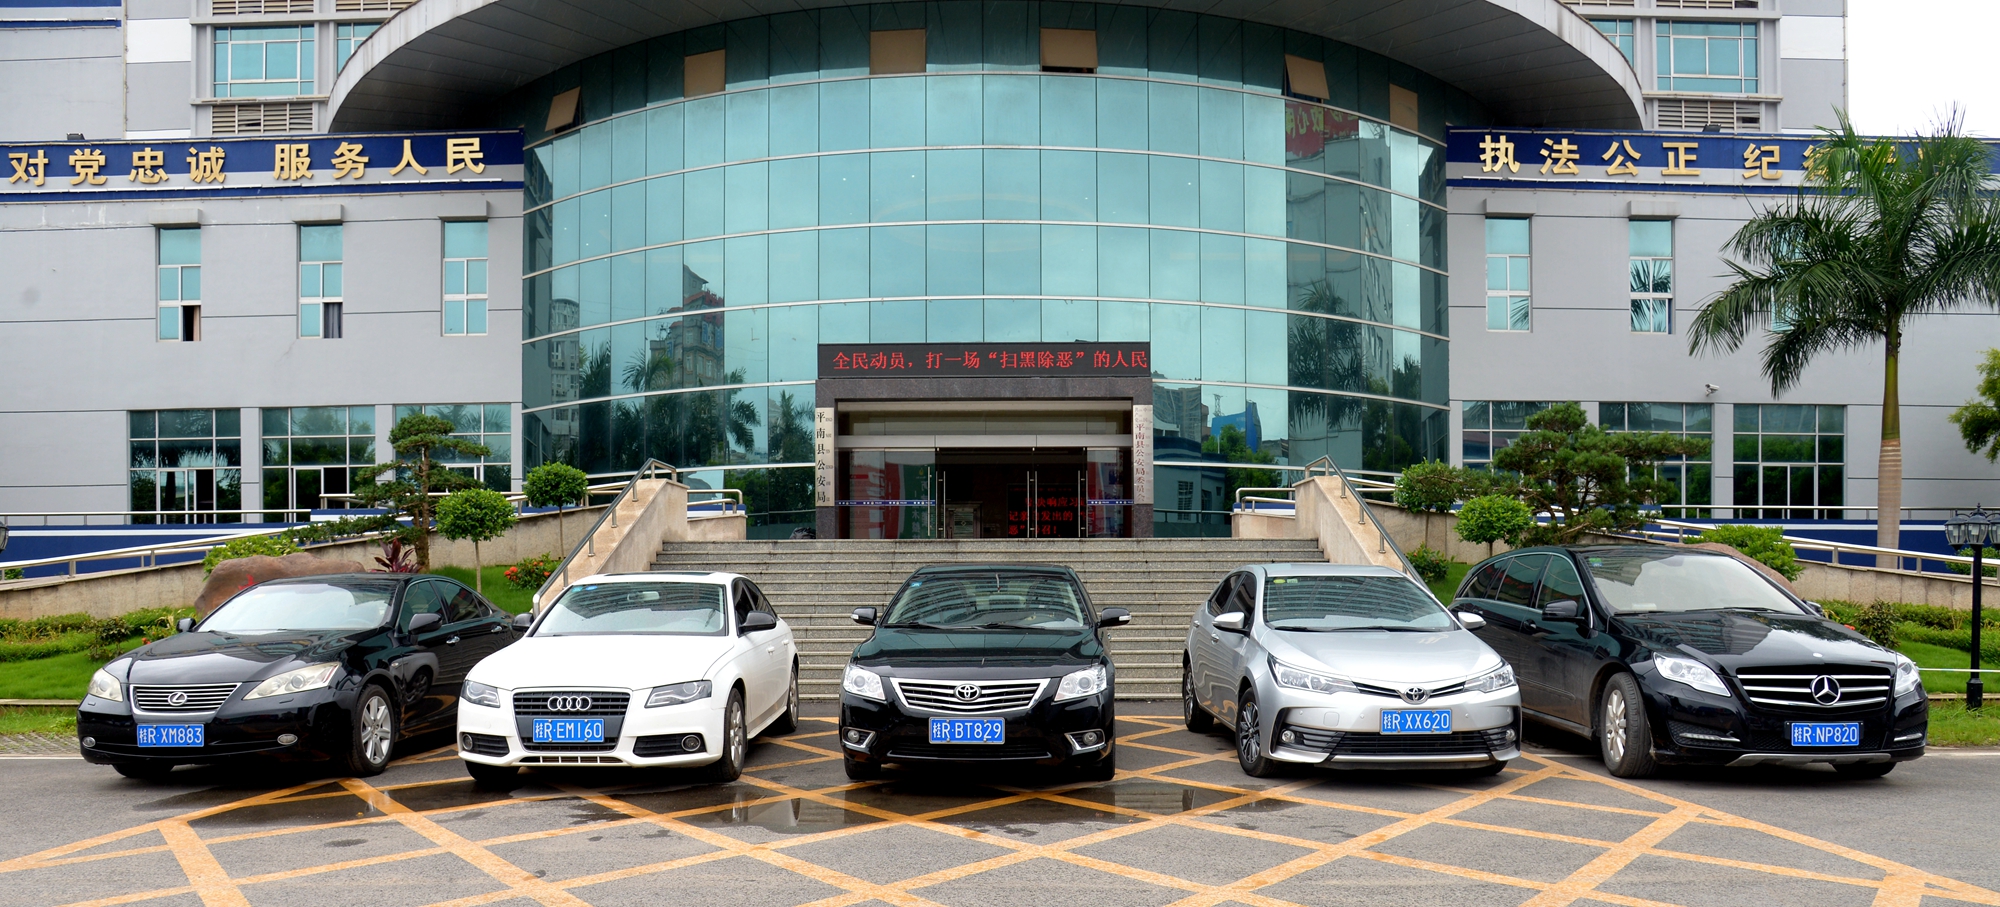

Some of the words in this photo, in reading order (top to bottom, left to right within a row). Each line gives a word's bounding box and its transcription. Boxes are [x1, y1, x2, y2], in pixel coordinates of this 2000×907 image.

[9, 147, 226, 186] 对党忠诚
[273, 137, 486, 181] 服务人民
[1479, 135, 1701, 176] 执法公正
[816, 411, 826, 503] 平南县公安局
